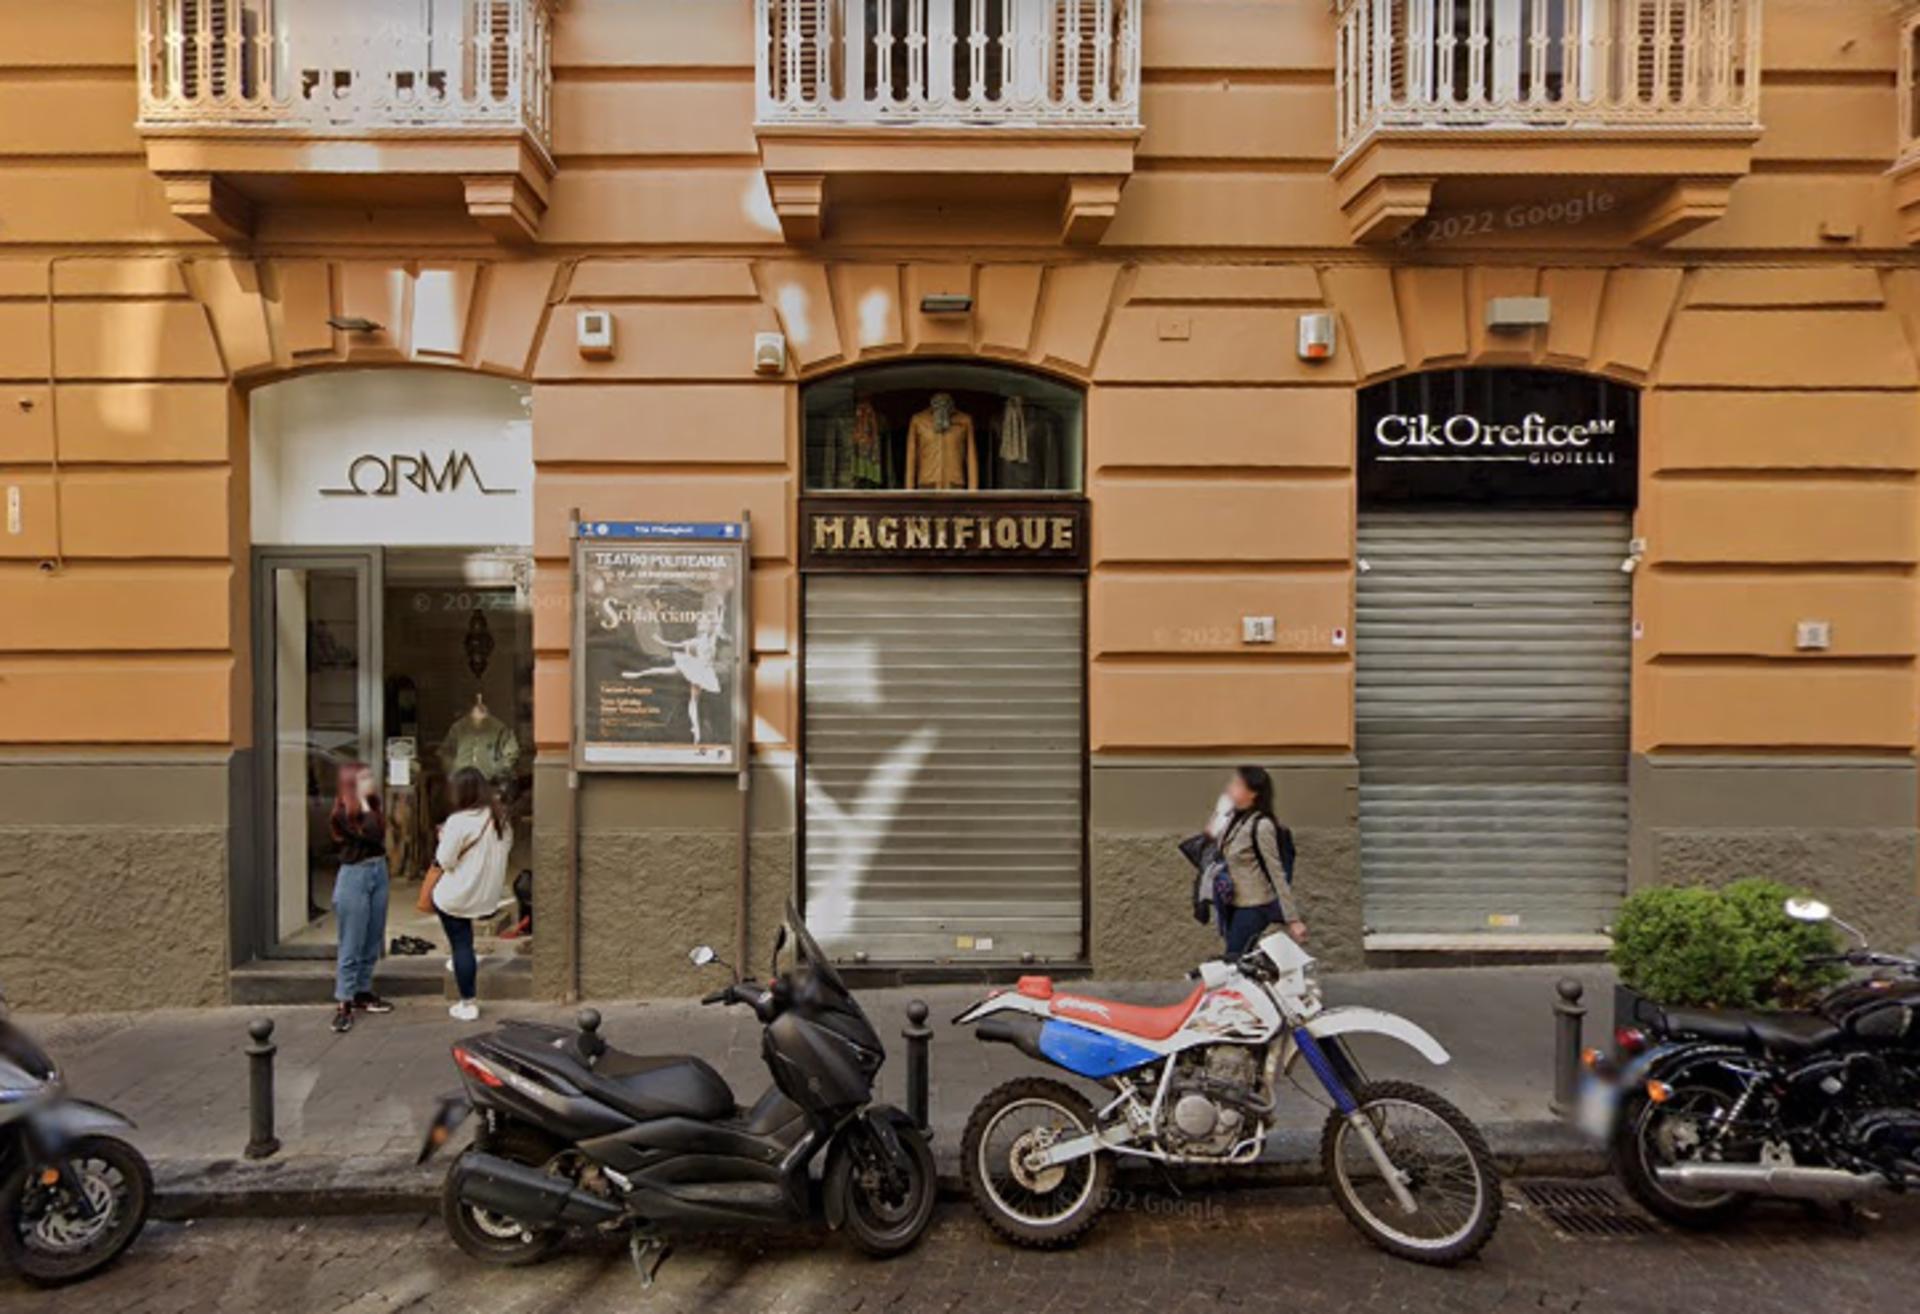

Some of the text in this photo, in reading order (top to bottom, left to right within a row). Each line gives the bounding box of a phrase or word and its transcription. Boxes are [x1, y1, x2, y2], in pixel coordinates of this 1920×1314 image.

[1375, 413, 1590, 446] CikOrefice
[1528, 451, 1615, 464] GIOIELLI
[812, 515, 1073, 549] MAGNIFIQUE
[595, 552, 647, 567] TEATRO
